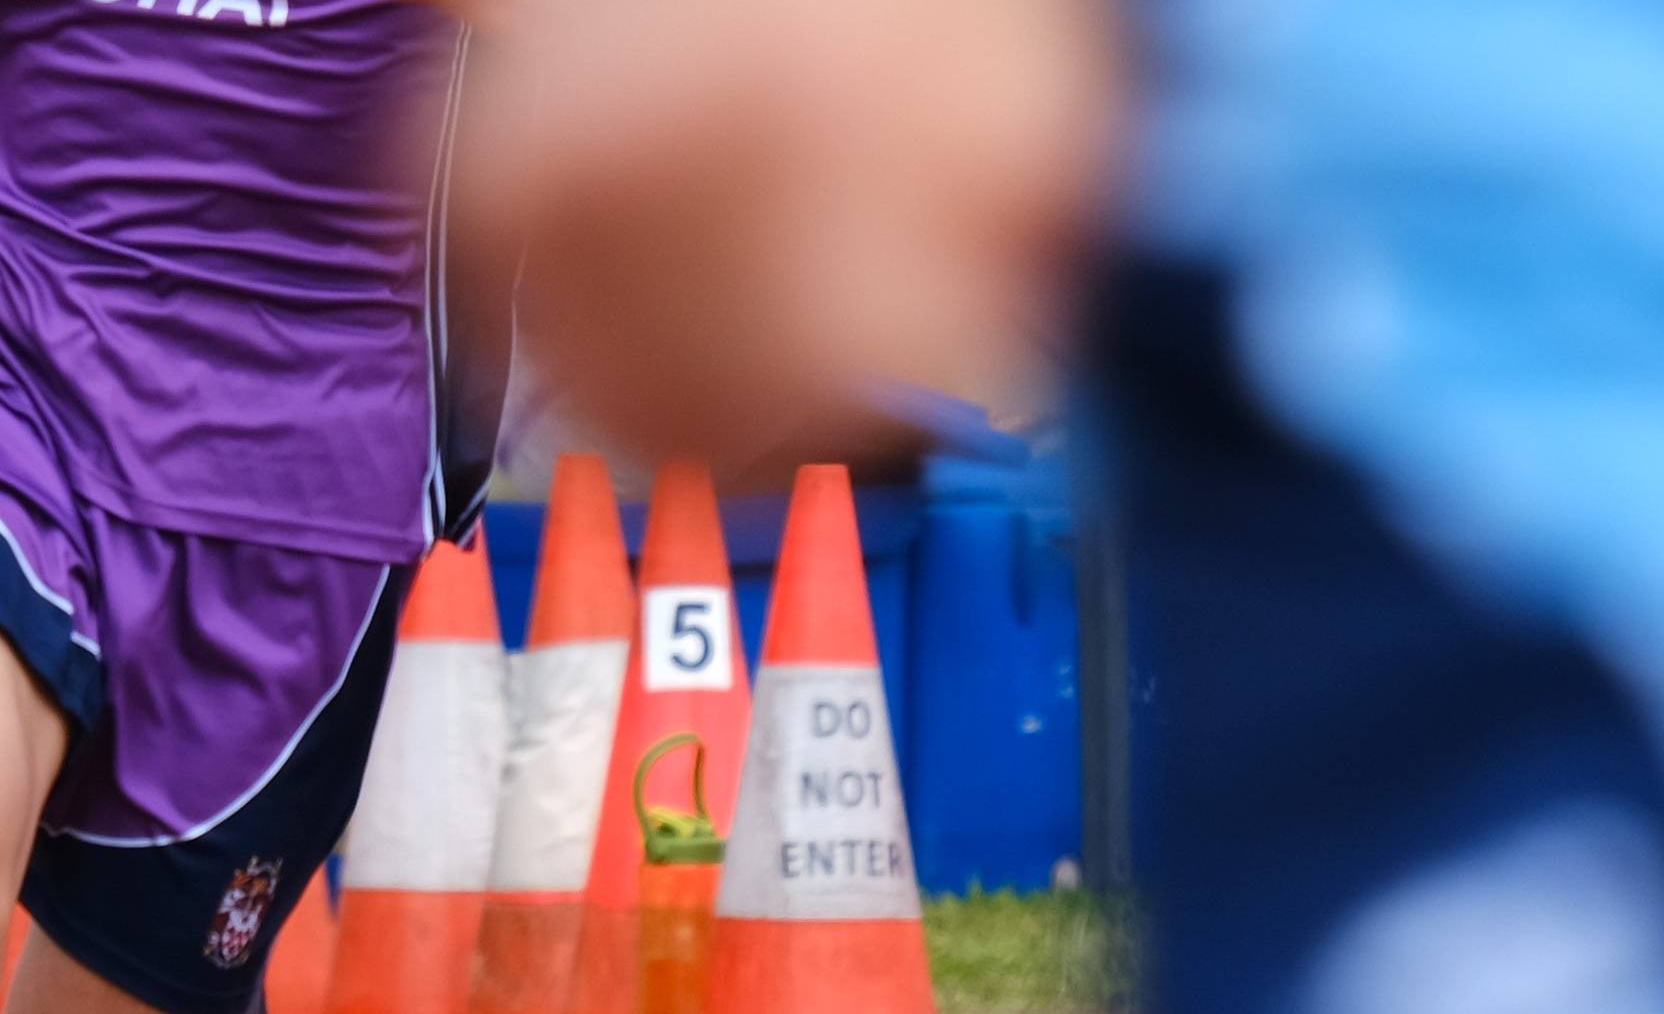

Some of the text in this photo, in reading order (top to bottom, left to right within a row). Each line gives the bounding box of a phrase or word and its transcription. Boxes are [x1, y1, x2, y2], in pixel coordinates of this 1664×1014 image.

[669, 601, 715, 673] 5
[811, 700, 873, 738] DO
[799, 771, 884, 808] NOT
[780, 839, 905, 878] ENTER
